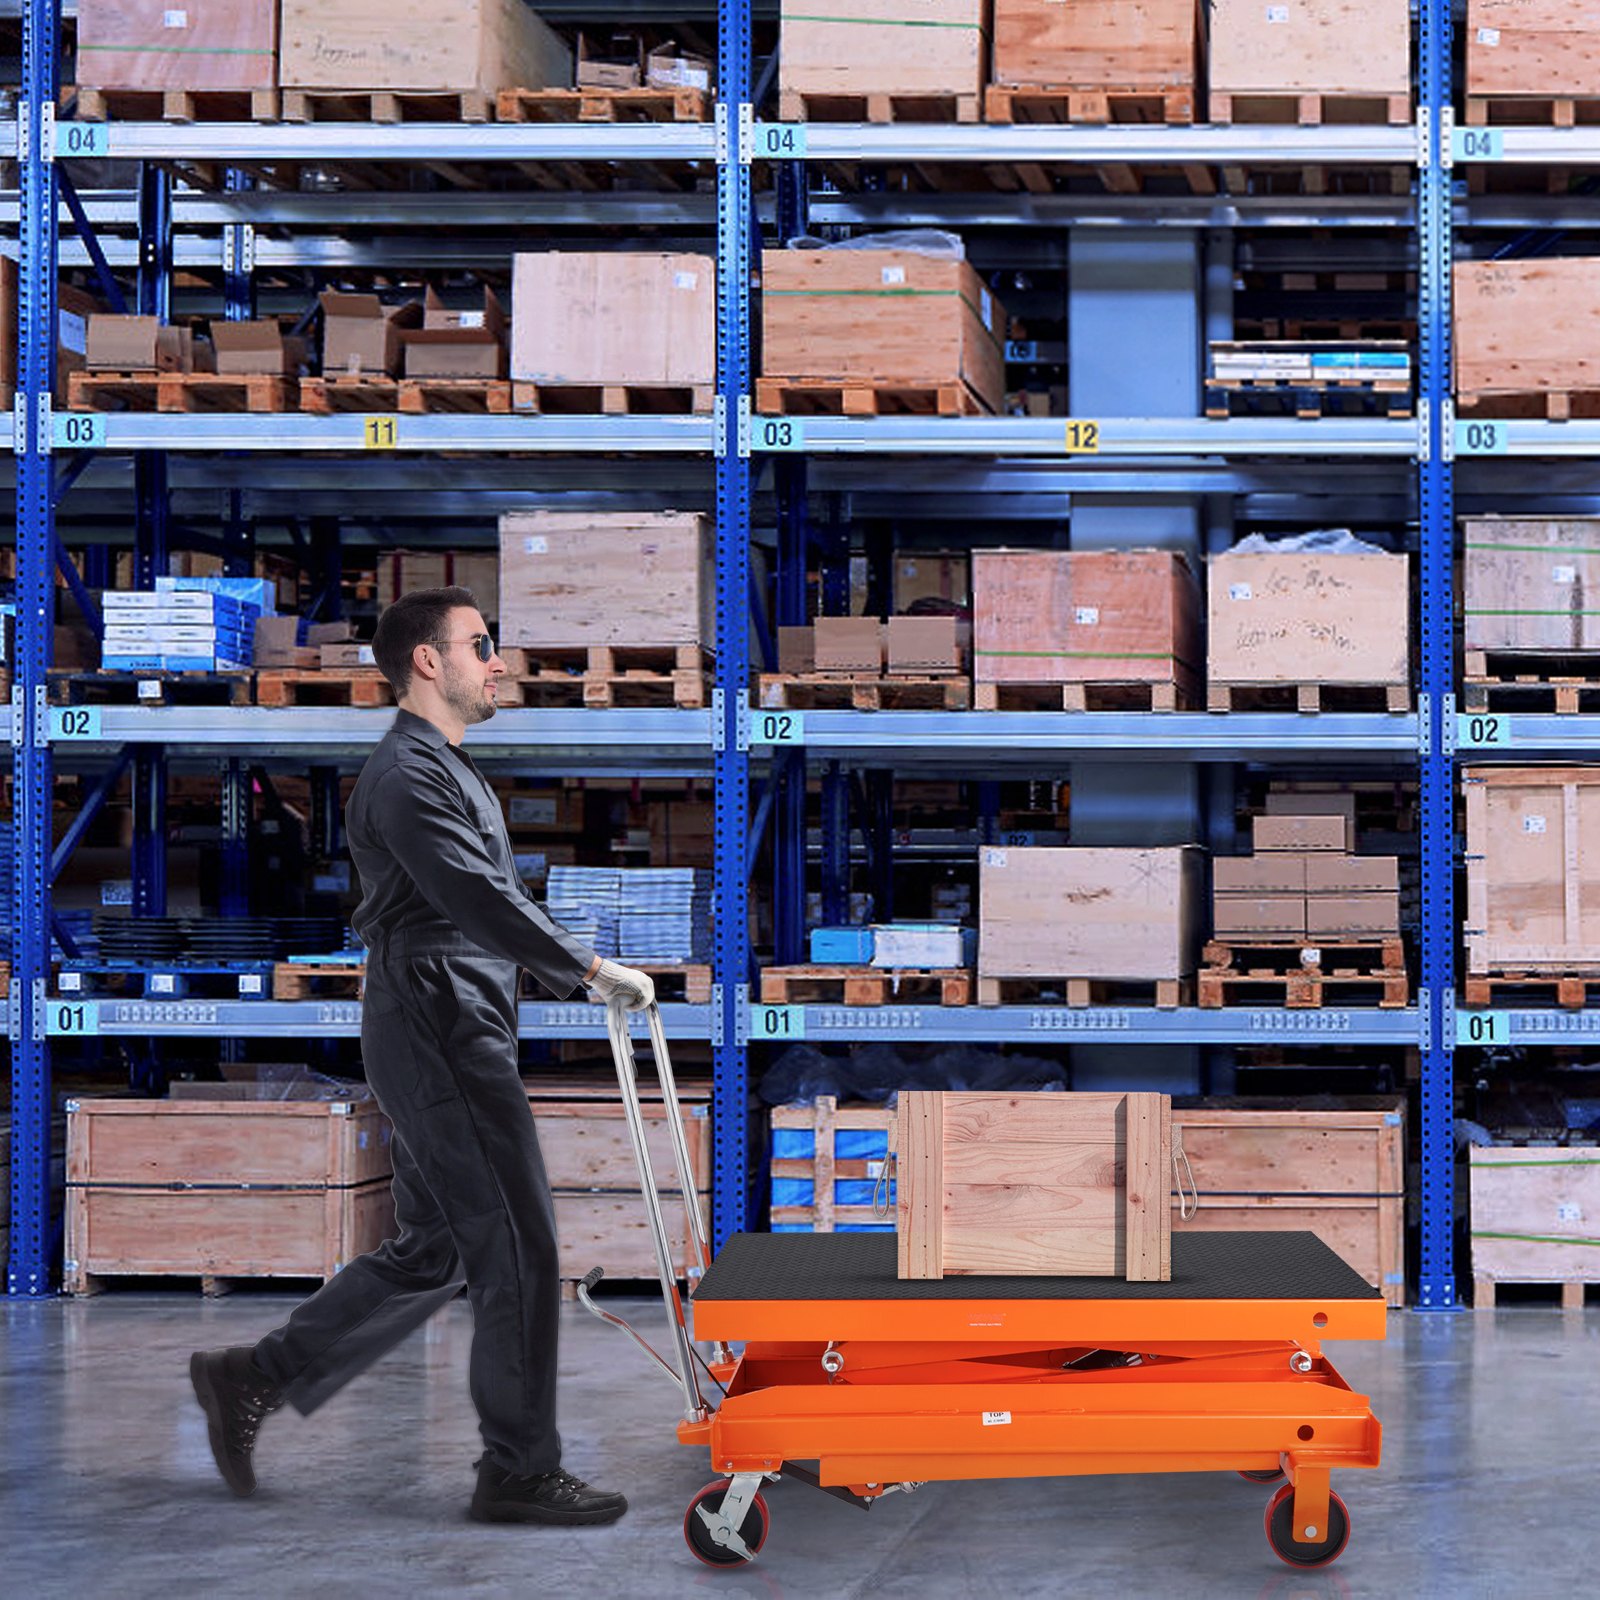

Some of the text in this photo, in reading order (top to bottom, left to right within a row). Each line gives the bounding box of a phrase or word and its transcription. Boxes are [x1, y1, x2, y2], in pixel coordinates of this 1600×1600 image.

[69, 128, 95, 151] 04
[767, 129, 795, 152] 04
[1464, 132, 1491, 155] 04
[66, 418, 93, 442] 03
[369, 421, 392, 443] 11
[765, 423, 791, 446] 03
[1070, 424, 1097, 447] 12
[1468, 425, 1495, 449] 03
[62, 711, 89, 734] 02
[765, 717, 791, 739] 02
[1471, 718, 1497, 742] 02
[59, 1006, 84, 1030] 01
[766, 1010, 790, 1034] 01
[1470, 1016, 1494, 1040] 01
